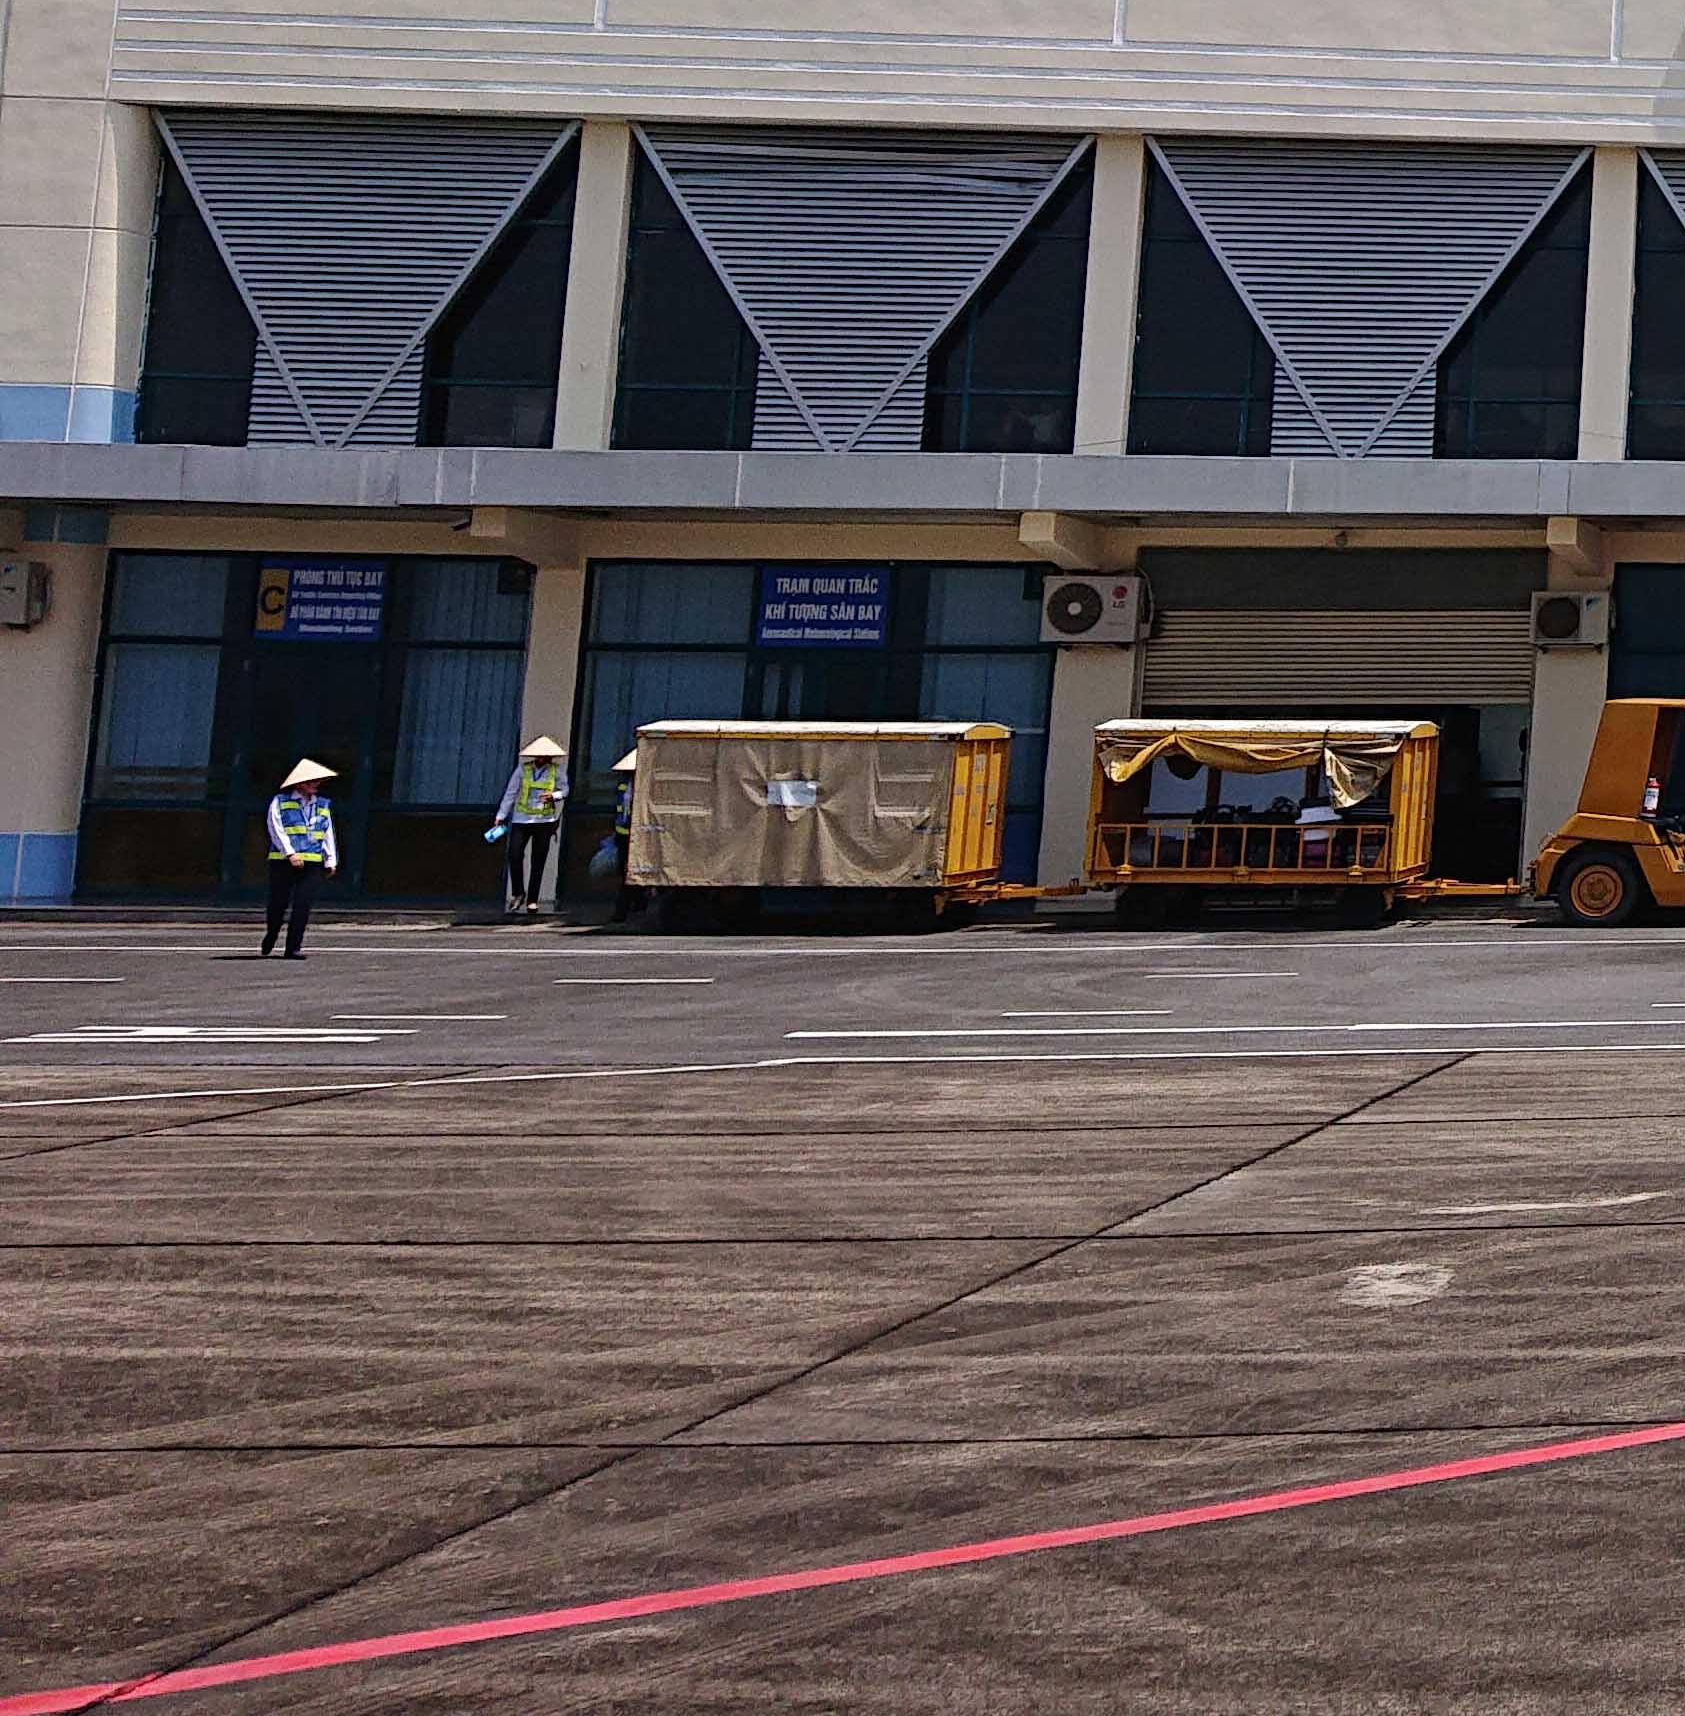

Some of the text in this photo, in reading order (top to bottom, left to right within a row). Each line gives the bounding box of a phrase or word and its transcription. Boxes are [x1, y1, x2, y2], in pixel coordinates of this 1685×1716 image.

[364, 571, 383, 587] BAY
[776, 577, 810, 596] TRẠM
[812, 578, 847, 595] QUAN
[260, 586, 286, 615] C
[1113, 601, 1126, 609] LG
[765, 600, 882, 622] KHÍ TƯỢNG SÂN BAY
